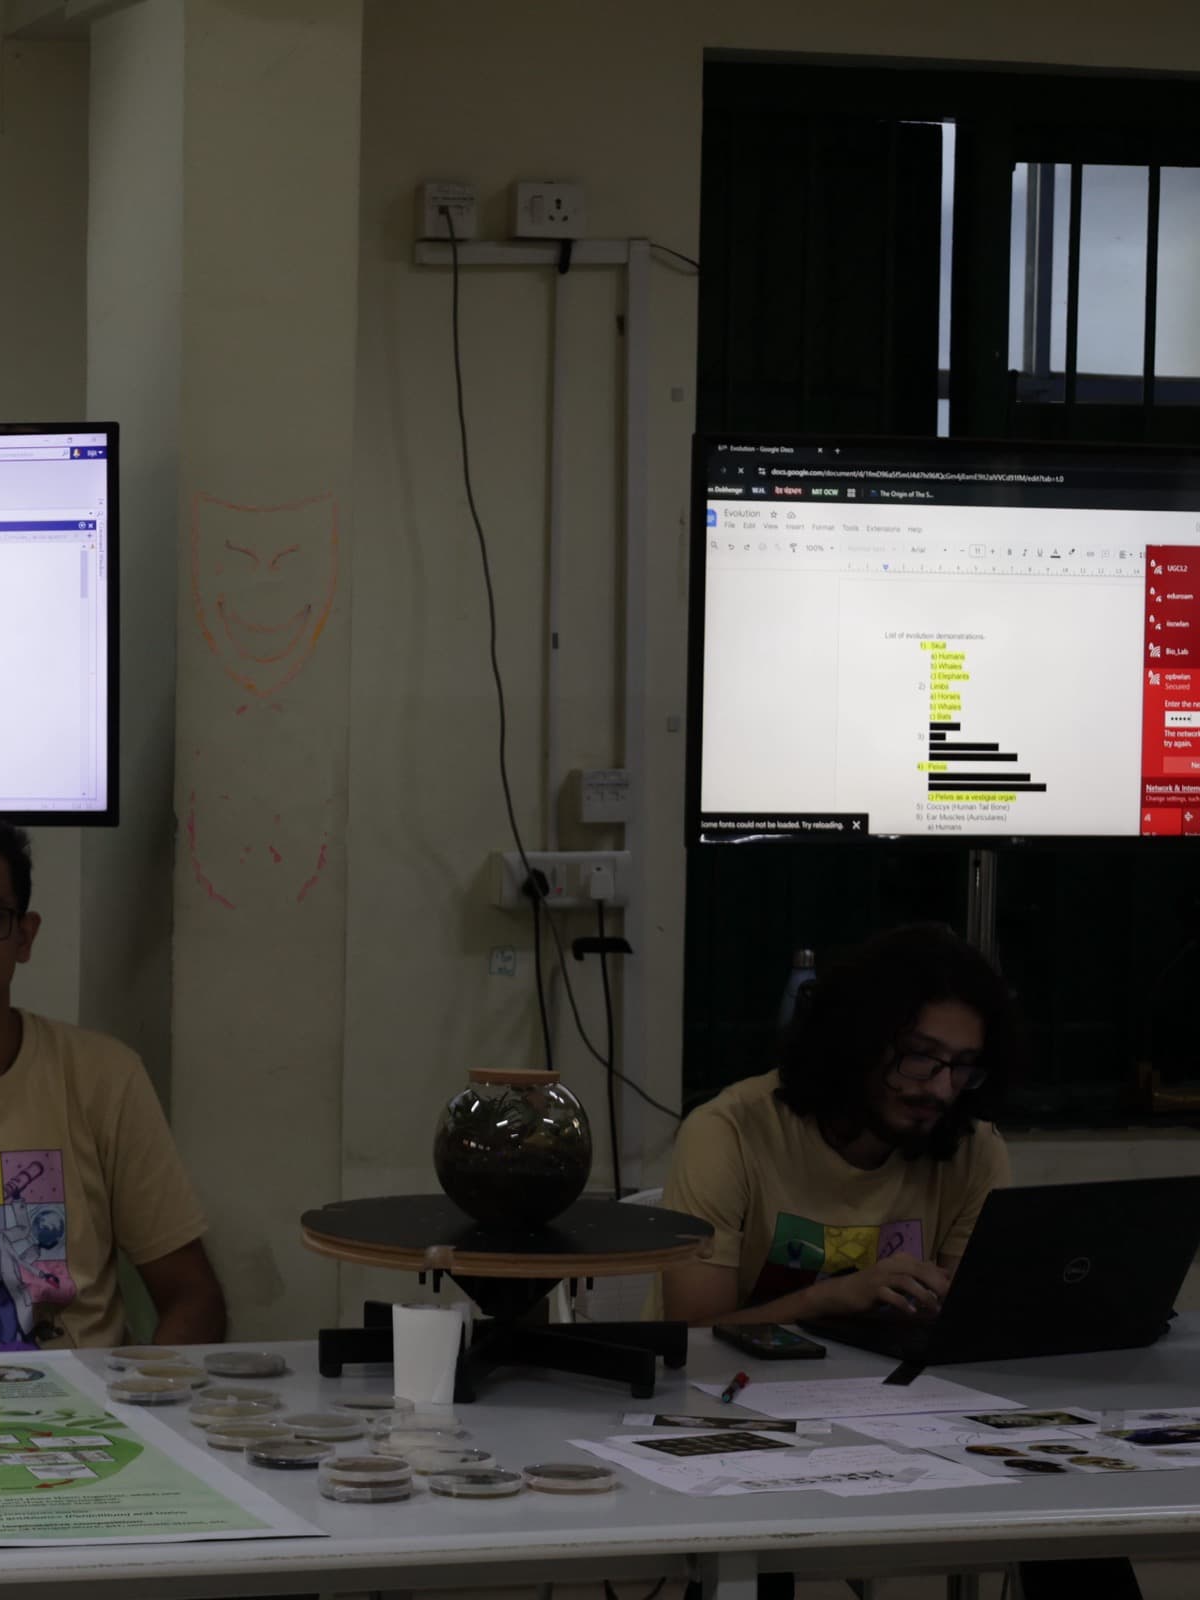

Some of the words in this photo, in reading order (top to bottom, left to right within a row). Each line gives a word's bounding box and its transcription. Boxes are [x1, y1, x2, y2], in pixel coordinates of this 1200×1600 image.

[760, 446, 780, 454] Google
[724, 509, 760, 518] Evolution
[843, 524, 859, 532] Tools
[867, 525, 900, 533] Extensions
[908, 526, 922, 534] Help
[806, 544, 824, 552] 100%
[938, 673, 969, 681] Elephants
[1165, 700, 1180, 708] Enter
[1181, 700, 1191, 708] the
[1164, 740, 1172, 748] try
[1146, 784, 1172, 793] Network
[935, 793, 954, 801] Pelvis
[1146, 795, 1165, 803] Change
[927, 803, 950, 811] Coccyx
[952, 803, 977, 811] (Human
[991, 803, 1009, 811] Bone)
[719, 820, 735, 829] fonts
[737, 821, 754, 829] could
[756, 821, 766, 829] not
[768, 821, 776, 829] be
[777, 821, 800, 829] loaded.
[802, 821, 811, 830] Try
